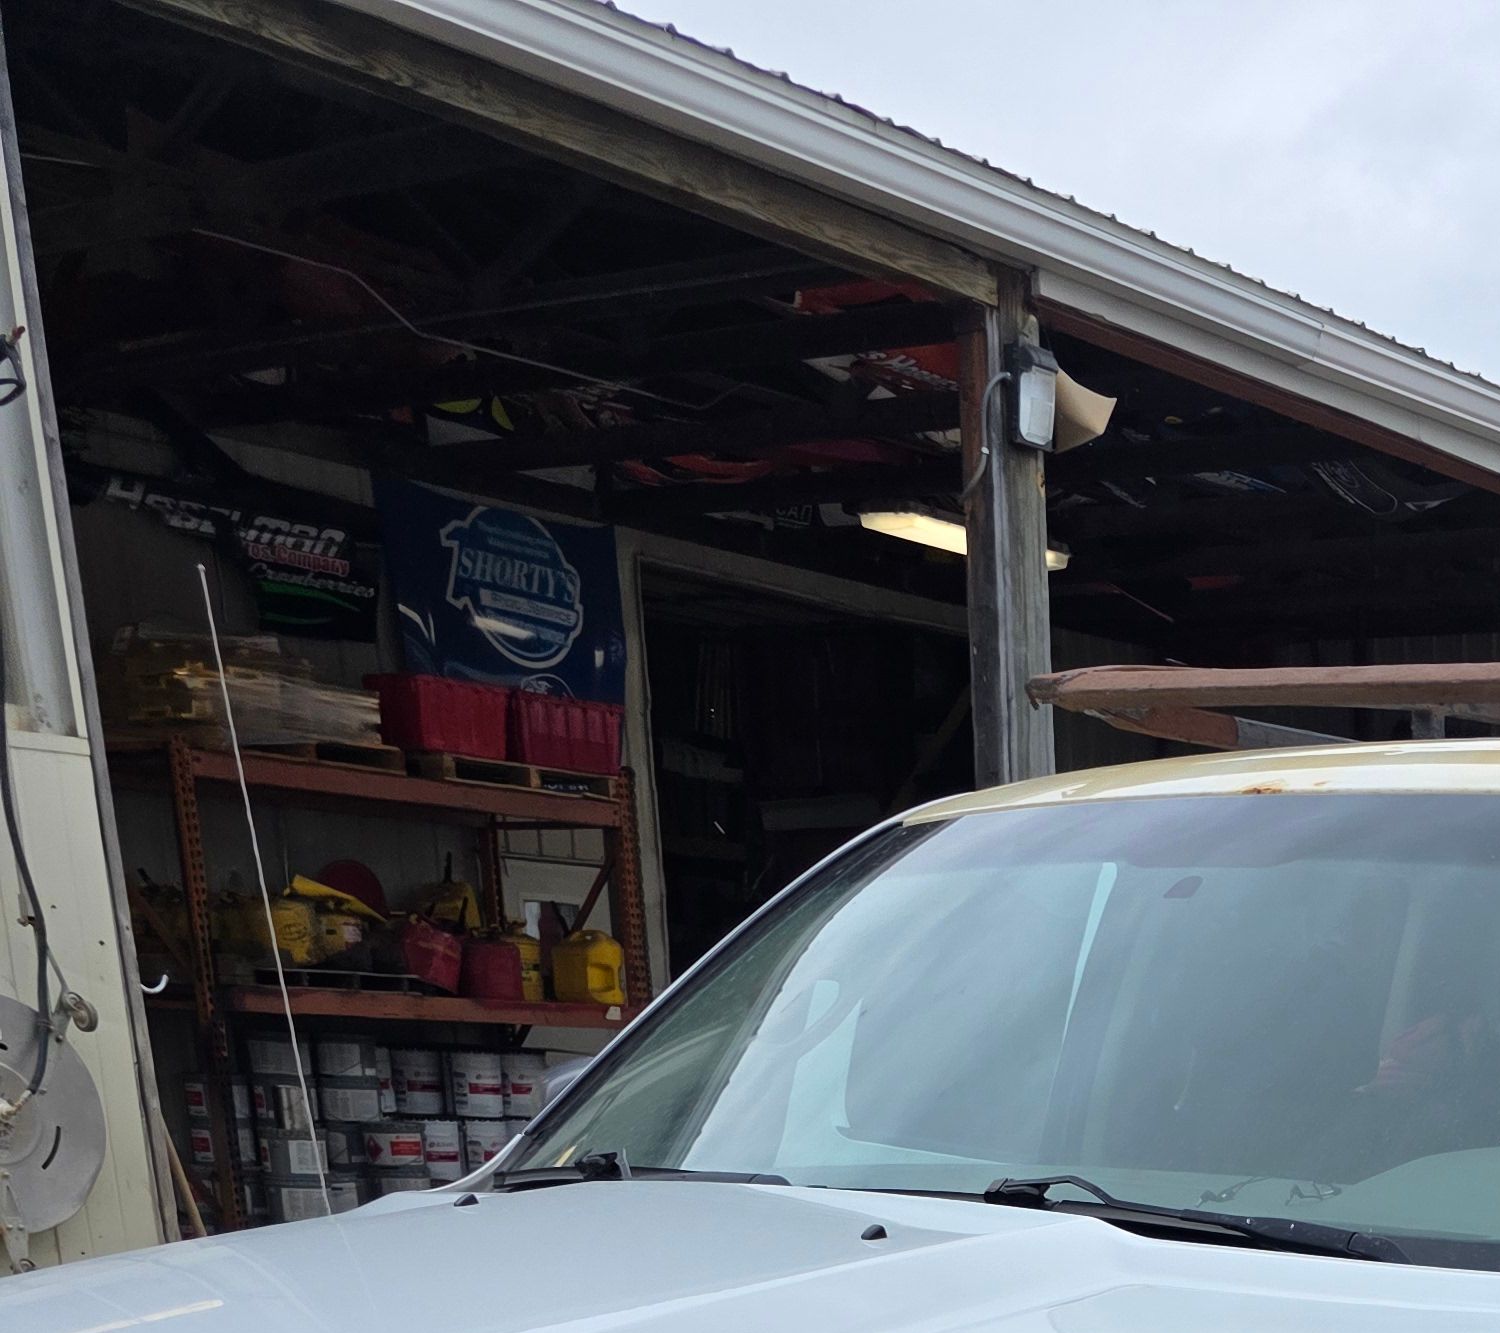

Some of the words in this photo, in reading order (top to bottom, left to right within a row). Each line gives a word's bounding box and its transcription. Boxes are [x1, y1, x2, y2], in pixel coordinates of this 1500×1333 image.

[275, 544, 351, 577] Company
[458, 546, 577, 604] SHORTY'S
[249, 562, 376, 598] Cranberries
